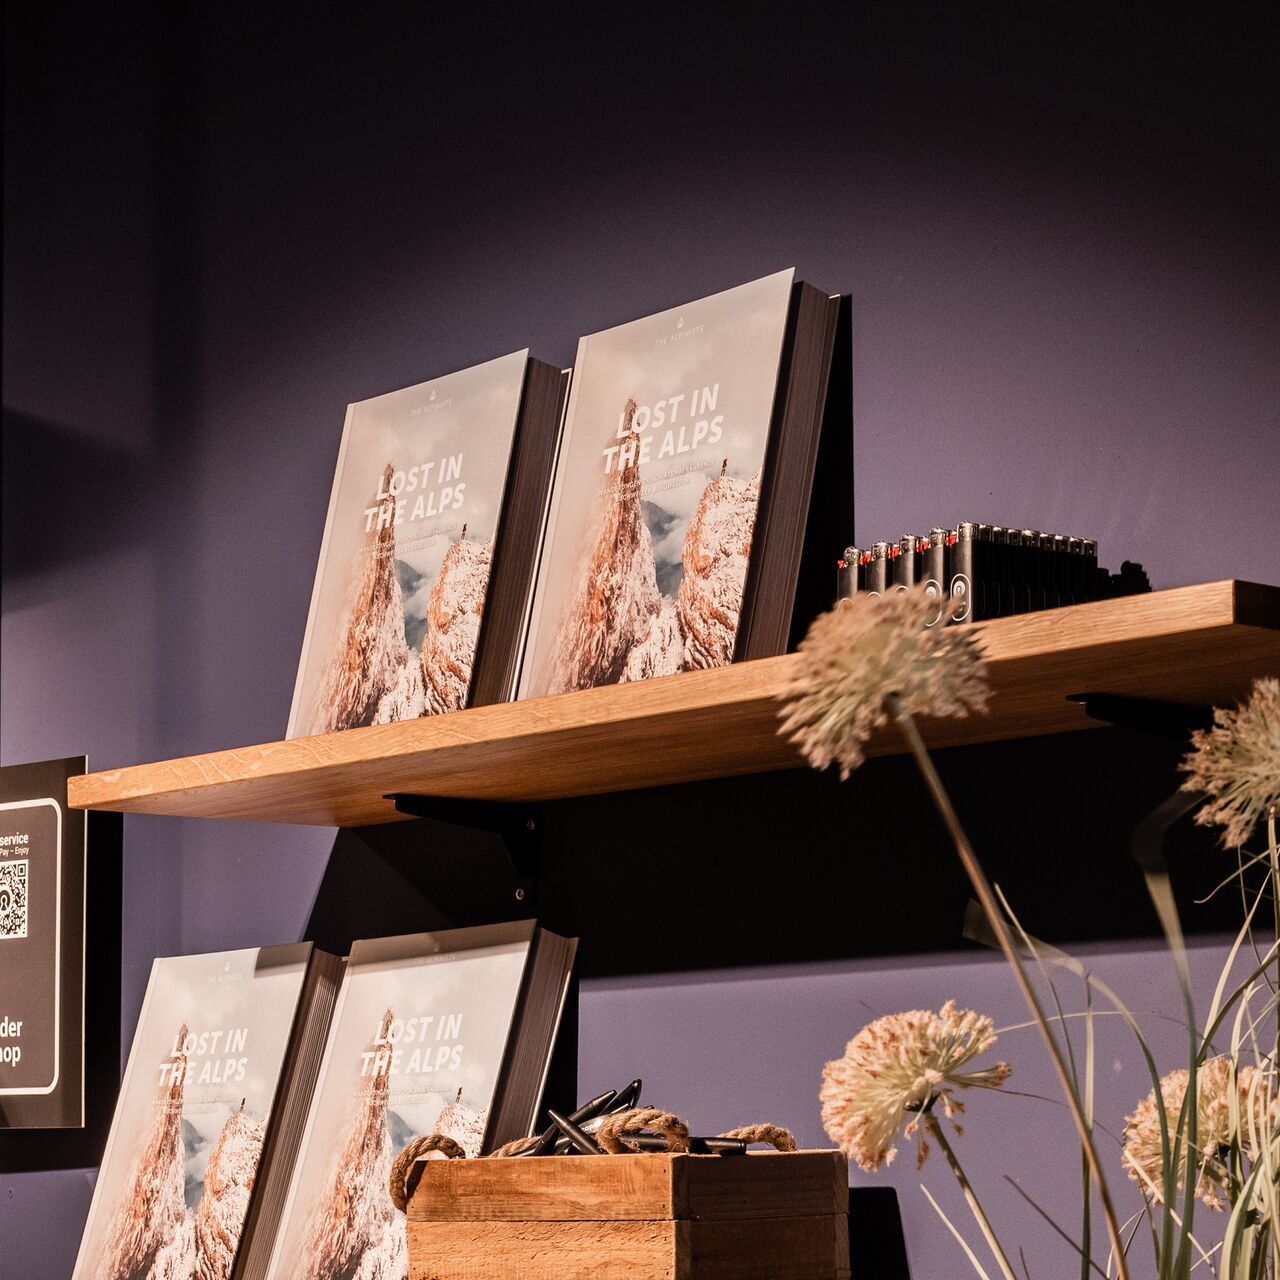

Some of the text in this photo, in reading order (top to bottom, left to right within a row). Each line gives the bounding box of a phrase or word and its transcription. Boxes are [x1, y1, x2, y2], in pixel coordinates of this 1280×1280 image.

[655, 337, 668, 348] THE
[616, 383, 720, 439] LOST IN
[603, 414, 724, 474] THE ALPS
[376, 452, 464, 501] LOST IN
[363, 482, 466, 533] THE ALPS
[0, 832, 29, 846] service
[0, 848, 9, 857] Pay
[14, 846, 29, 856] Enjoy
[170, 1028, 249, 1058] LOST IN
[373, 1013, 463, 1045] LOST IN
[158, 1057, 249, 1087] THE ALPS
[360, 1044, 464, 1077] THE ALPS
